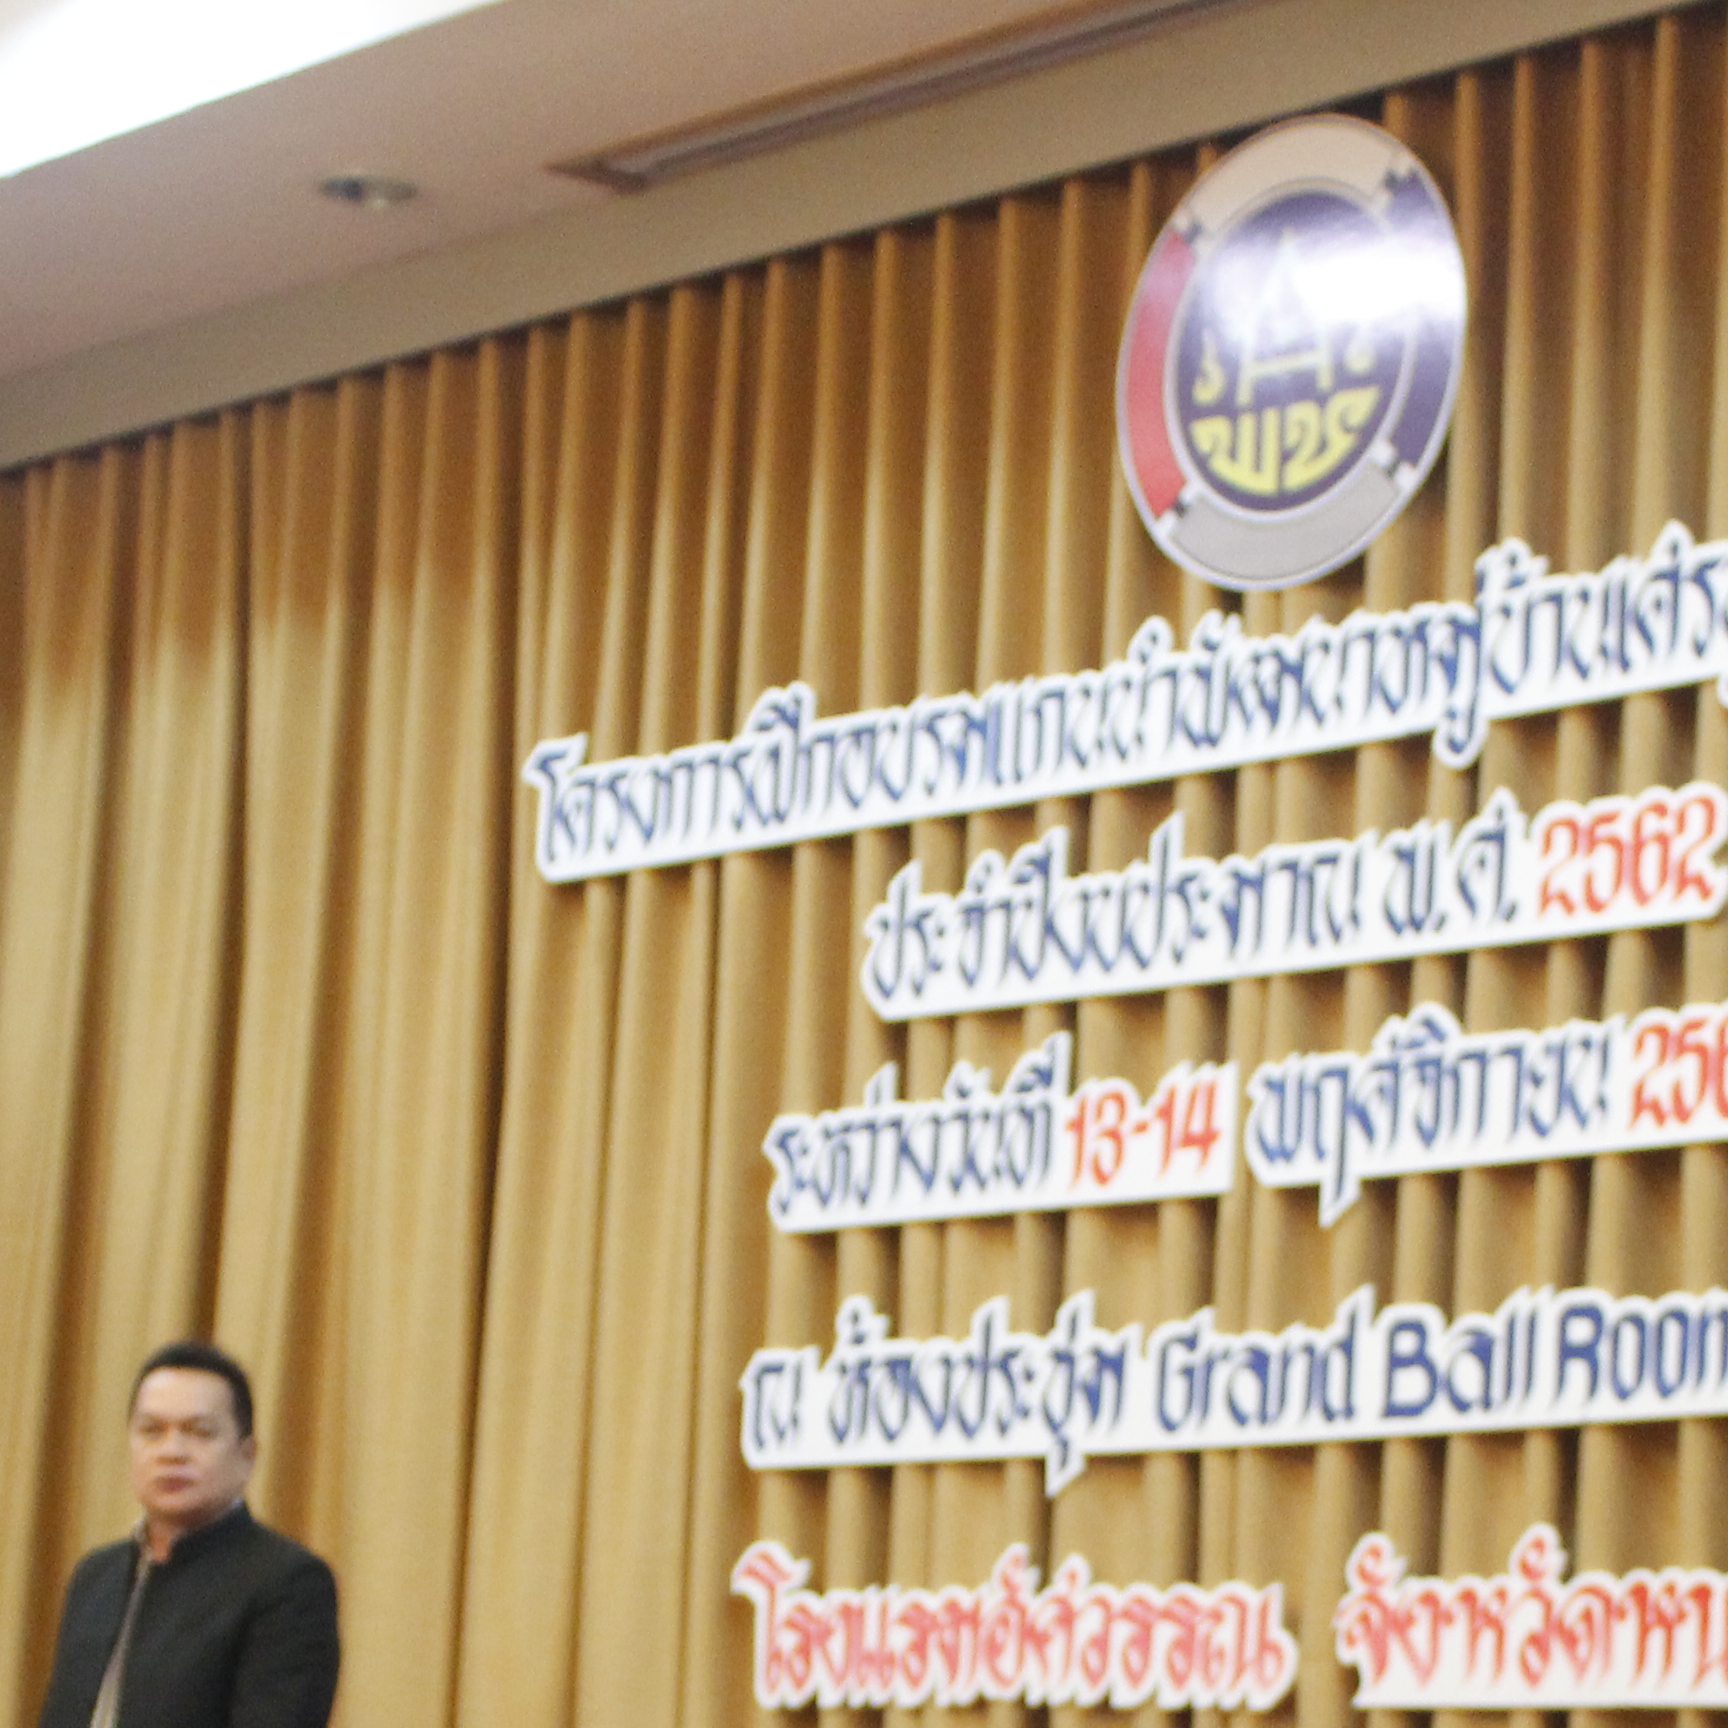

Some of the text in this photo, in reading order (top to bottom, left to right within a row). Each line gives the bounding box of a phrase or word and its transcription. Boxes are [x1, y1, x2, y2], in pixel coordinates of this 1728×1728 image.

[872, 795, 1718, 998] ประจำปีงบประมาณ พ.ศ. 2562
[774, 1036, 1056, 1214] ระหว่างวันที่
[1065, 1080, 1223, 1188] 13-14
[1254, 1016, 1614, 1200] พฤศจิกายน
[751, 1360, 806, 1450] ณ
[828, 1307, 1128, 1470] ห้องประชุม
[1156, 1312, 1356, 1432] Grand
[1380, 1306, 1538, 1419] Ball
